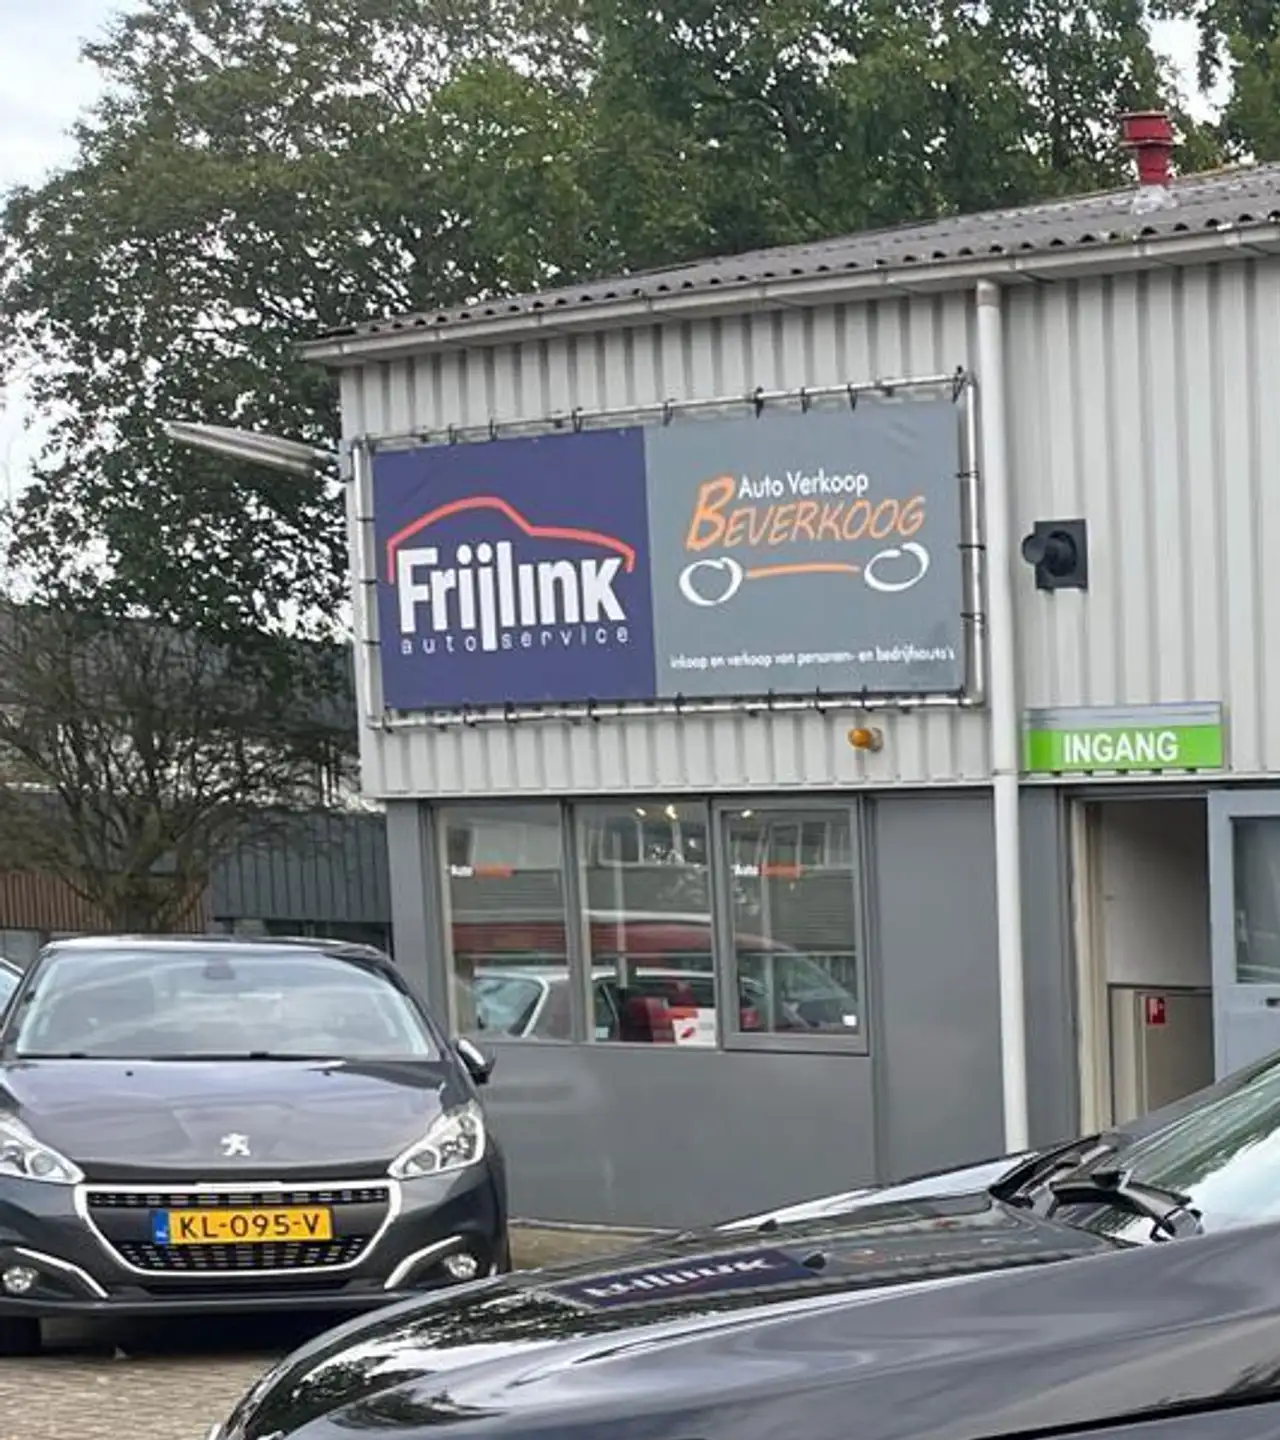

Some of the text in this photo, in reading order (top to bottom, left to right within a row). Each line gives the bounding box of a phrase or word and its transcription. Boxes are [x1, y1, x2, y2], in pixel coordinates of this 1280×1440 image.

[738, 467, 869, 499] Auto Verkoop
[727, 649, 773, 669] verkoop
[1063, 730, 1179, 763] INGANG
[179, 1213, 321, 1239] KL-095-V
